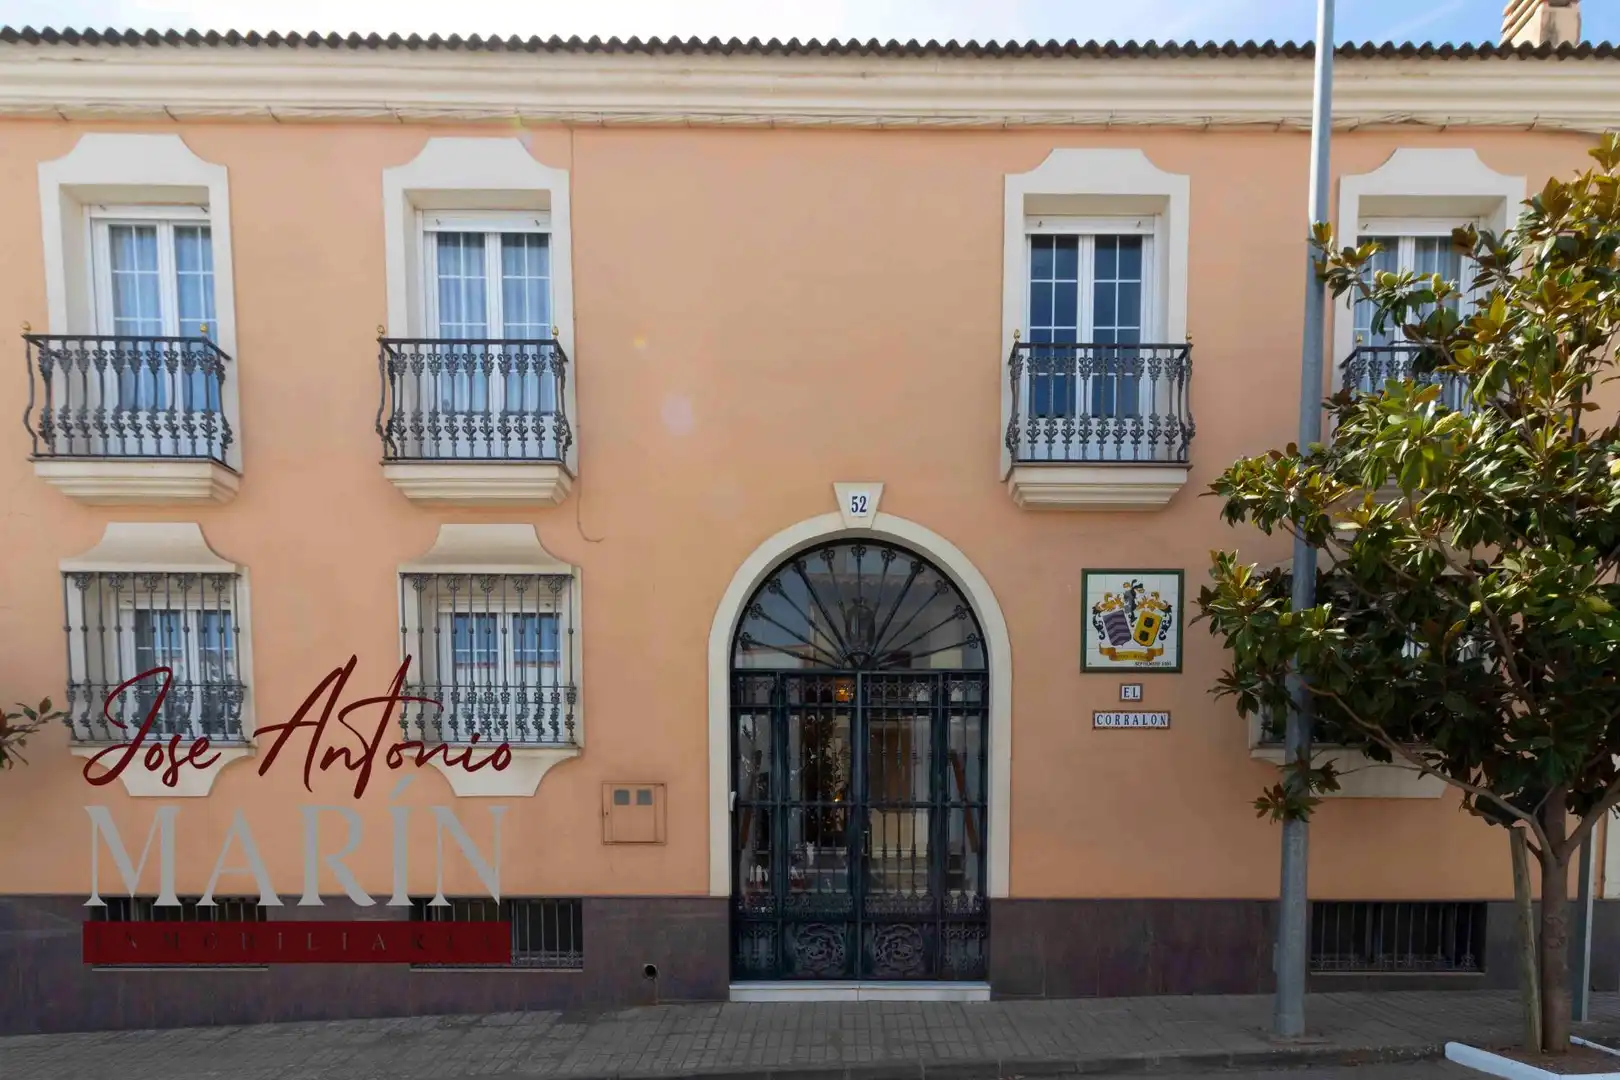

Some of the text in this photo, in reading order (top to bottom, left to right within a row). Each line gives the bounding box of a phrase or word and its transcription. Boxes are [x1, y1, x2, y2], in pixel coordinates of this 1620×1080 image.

[851, 495, 867, 513] 52
[1123, 687, 1139, 698] EL
[1096, 714, 1166, 726] CORRALON
